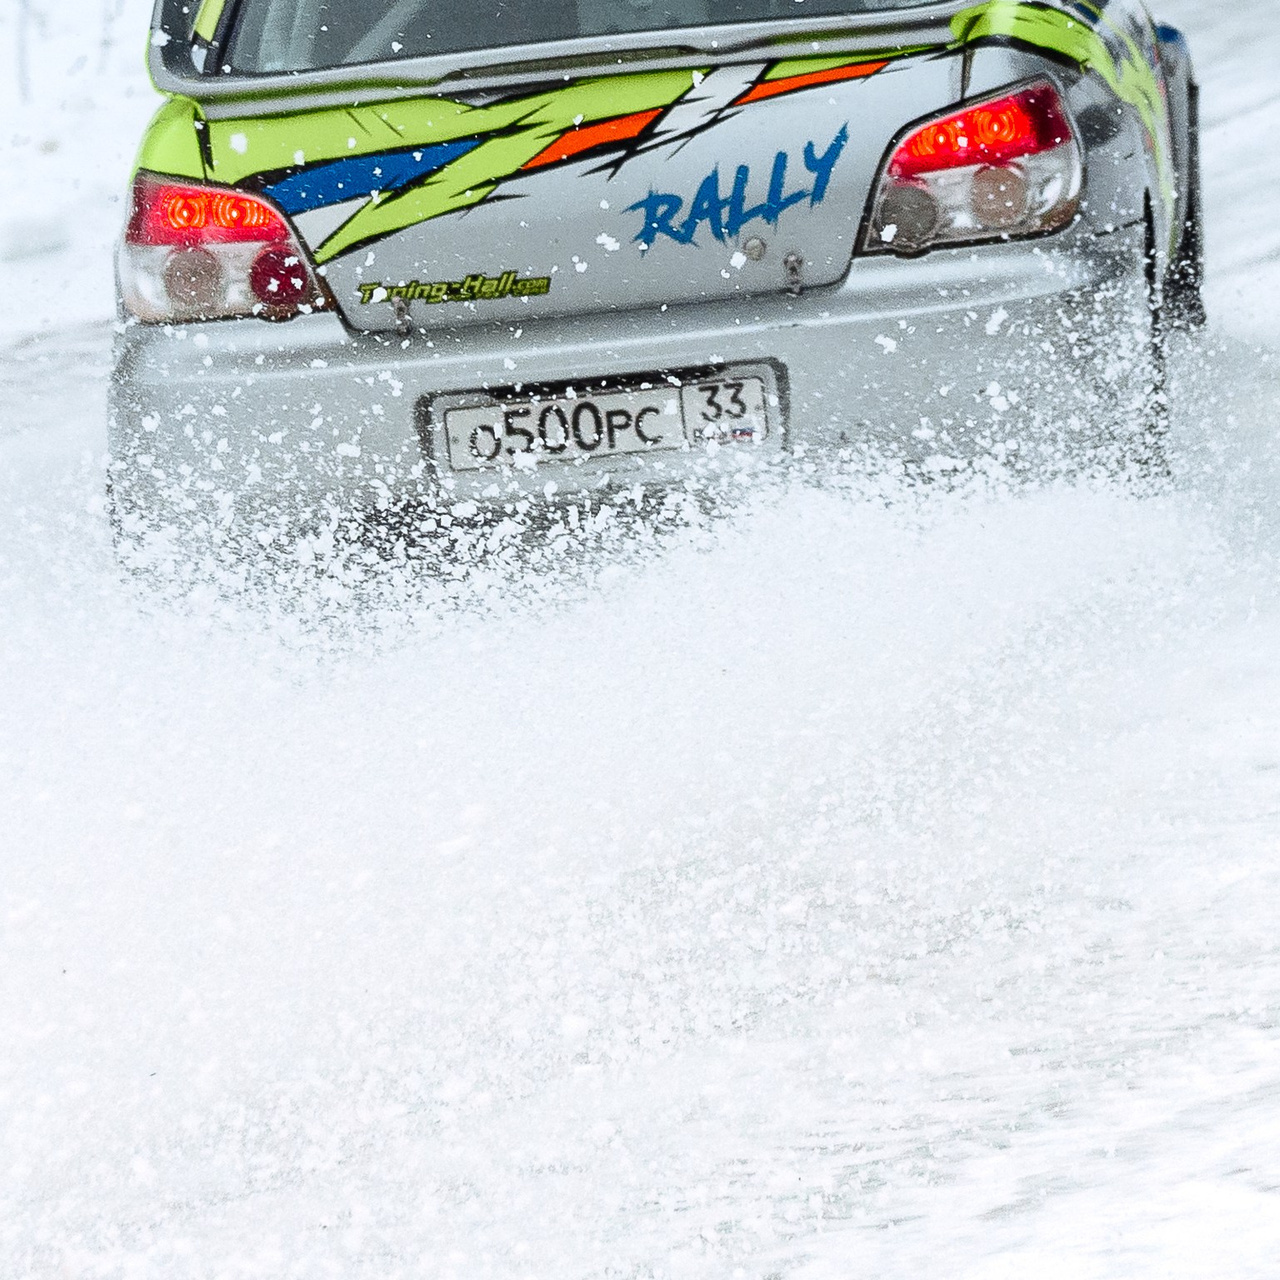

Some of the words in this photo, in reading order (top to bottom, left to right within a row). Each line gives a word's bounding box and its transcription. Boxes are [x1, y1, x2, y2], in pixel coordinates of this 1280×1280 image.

[624, 122, 849, 255] RALLY
[359, 272, 551, 305] Tning-Hall.com
[699, 382, 747, 422] 33
